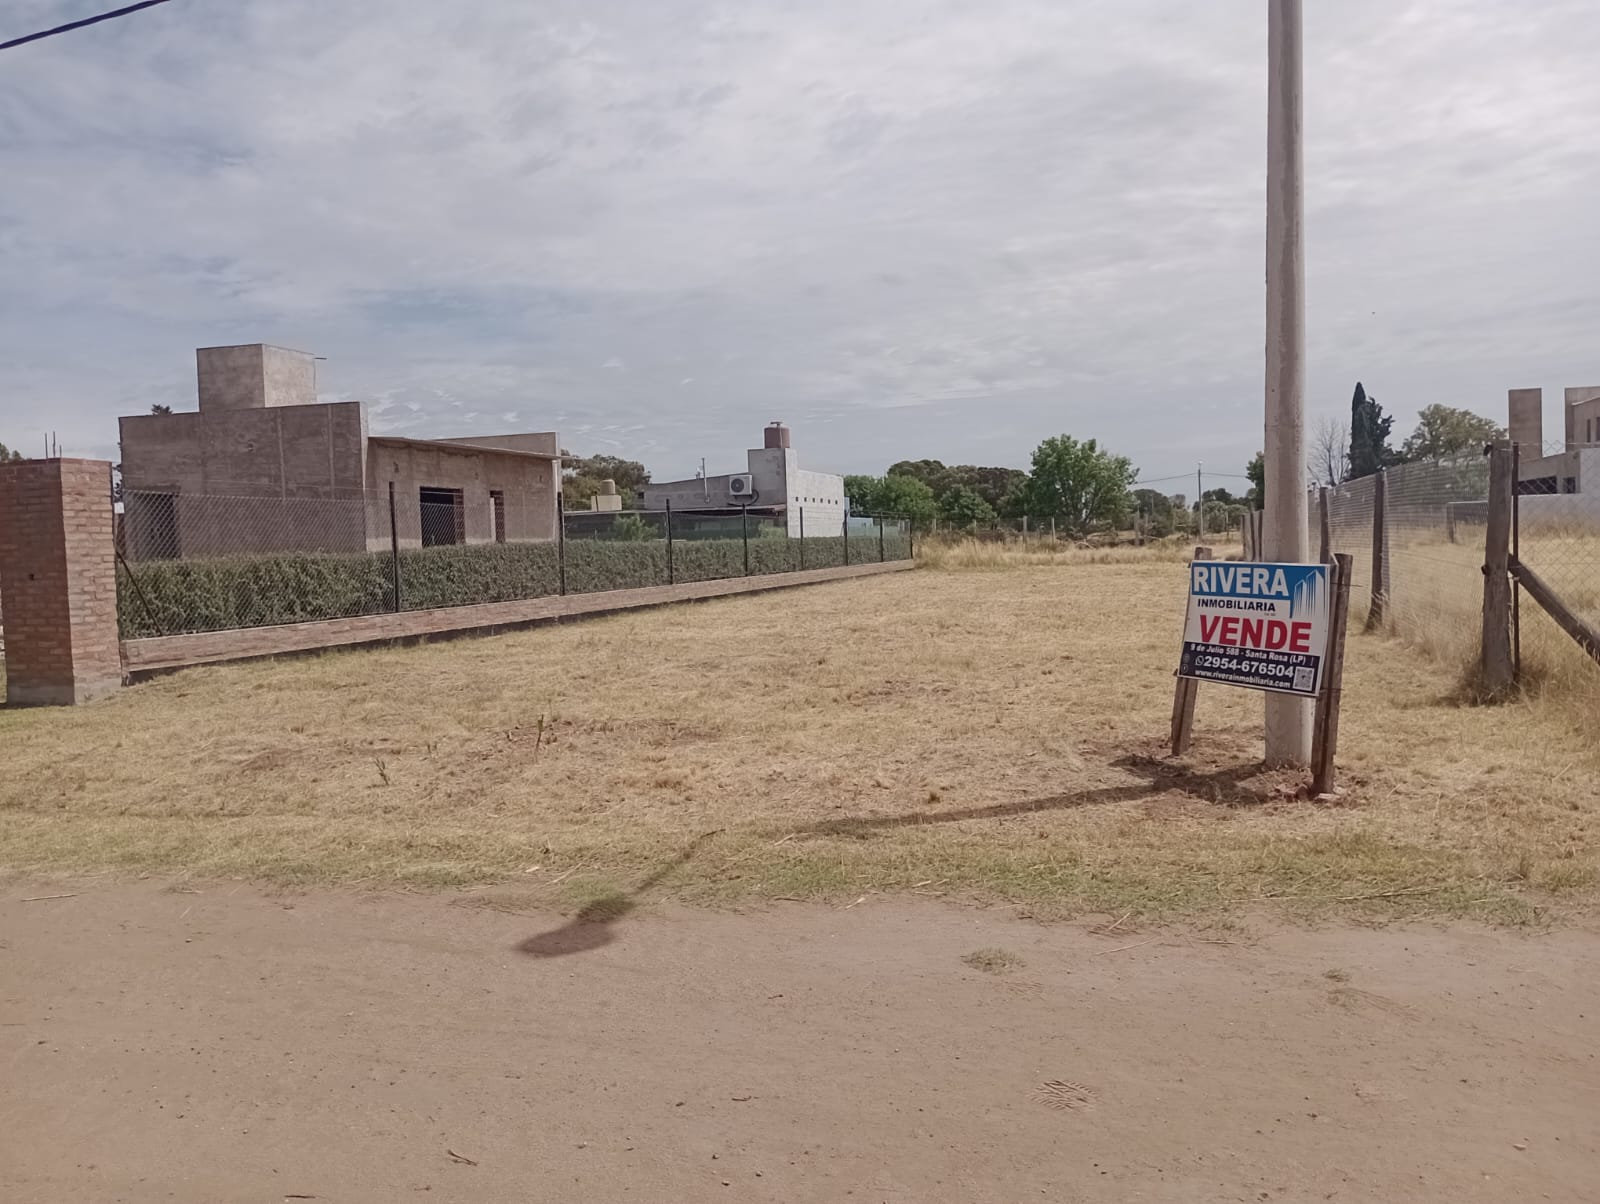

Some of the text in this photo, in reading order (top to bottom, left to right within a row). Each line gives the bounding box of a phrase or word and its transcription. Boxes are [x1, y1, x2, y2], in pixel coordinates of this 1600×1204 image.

[1193, 566, 1289, 596] RIVERA
[1197, 599, 1276, 612] INMOBILIARIA
[1200, 615, 1312, 653] VENDE
[1196, 644, 1205, 652] de
[1206, 645, 1223, 654] Julio
[1245, 649, 1267, 660] Santa
[1269, 652, 1288, 662] Rosa
[1289, 654, 1306, 665] (LP)
[1203, 656, 1294, 678] 2954-676504
[1195, 669, 1291, 688] www.riverainmobiliaria.com
